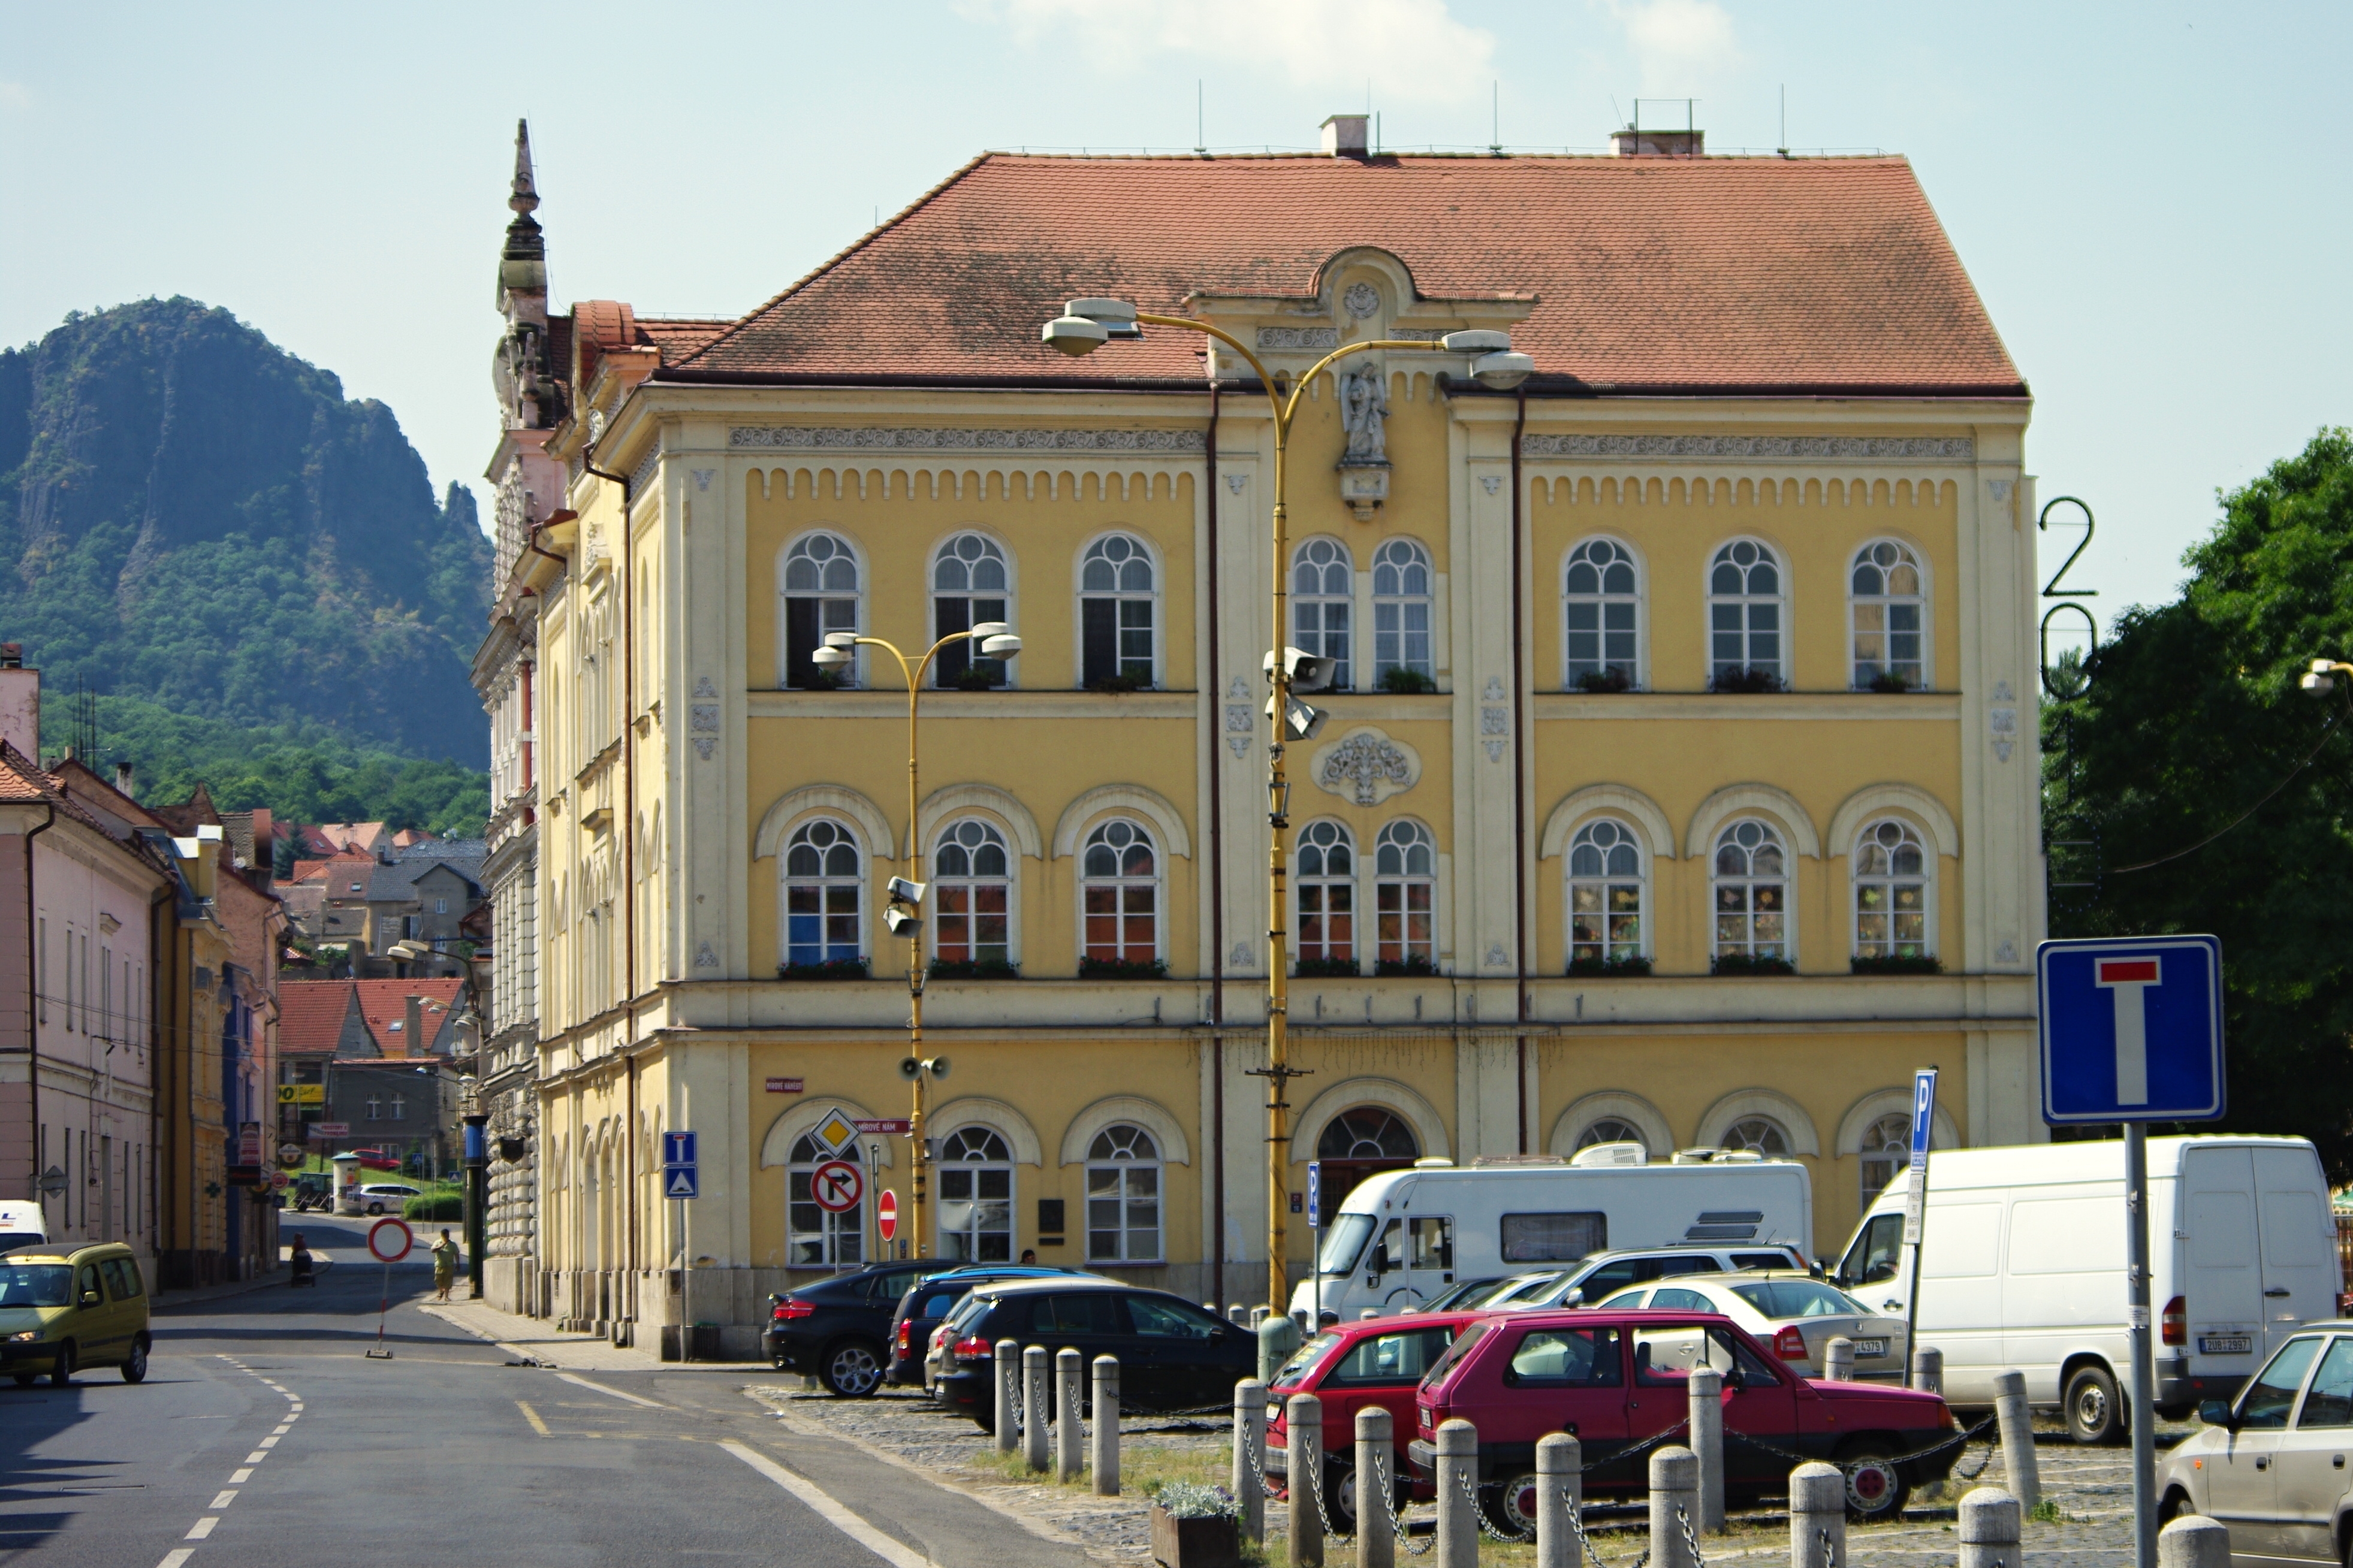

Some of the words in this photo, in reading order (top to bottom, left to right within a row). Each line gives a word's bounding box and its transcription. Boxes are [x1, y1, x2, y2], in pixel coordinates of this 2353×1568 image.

[1917, 1079, 1929, 1132] P
[858, 1122, 880, 1131] MÍROVÉ
[1310, 1171, 1316, 1206] P
[1861, 1342, 1880, 1352] 4379
[2207, 1340, 2222, 1351] 2U8
[2227, 1340, 2247, 1351] 2997
